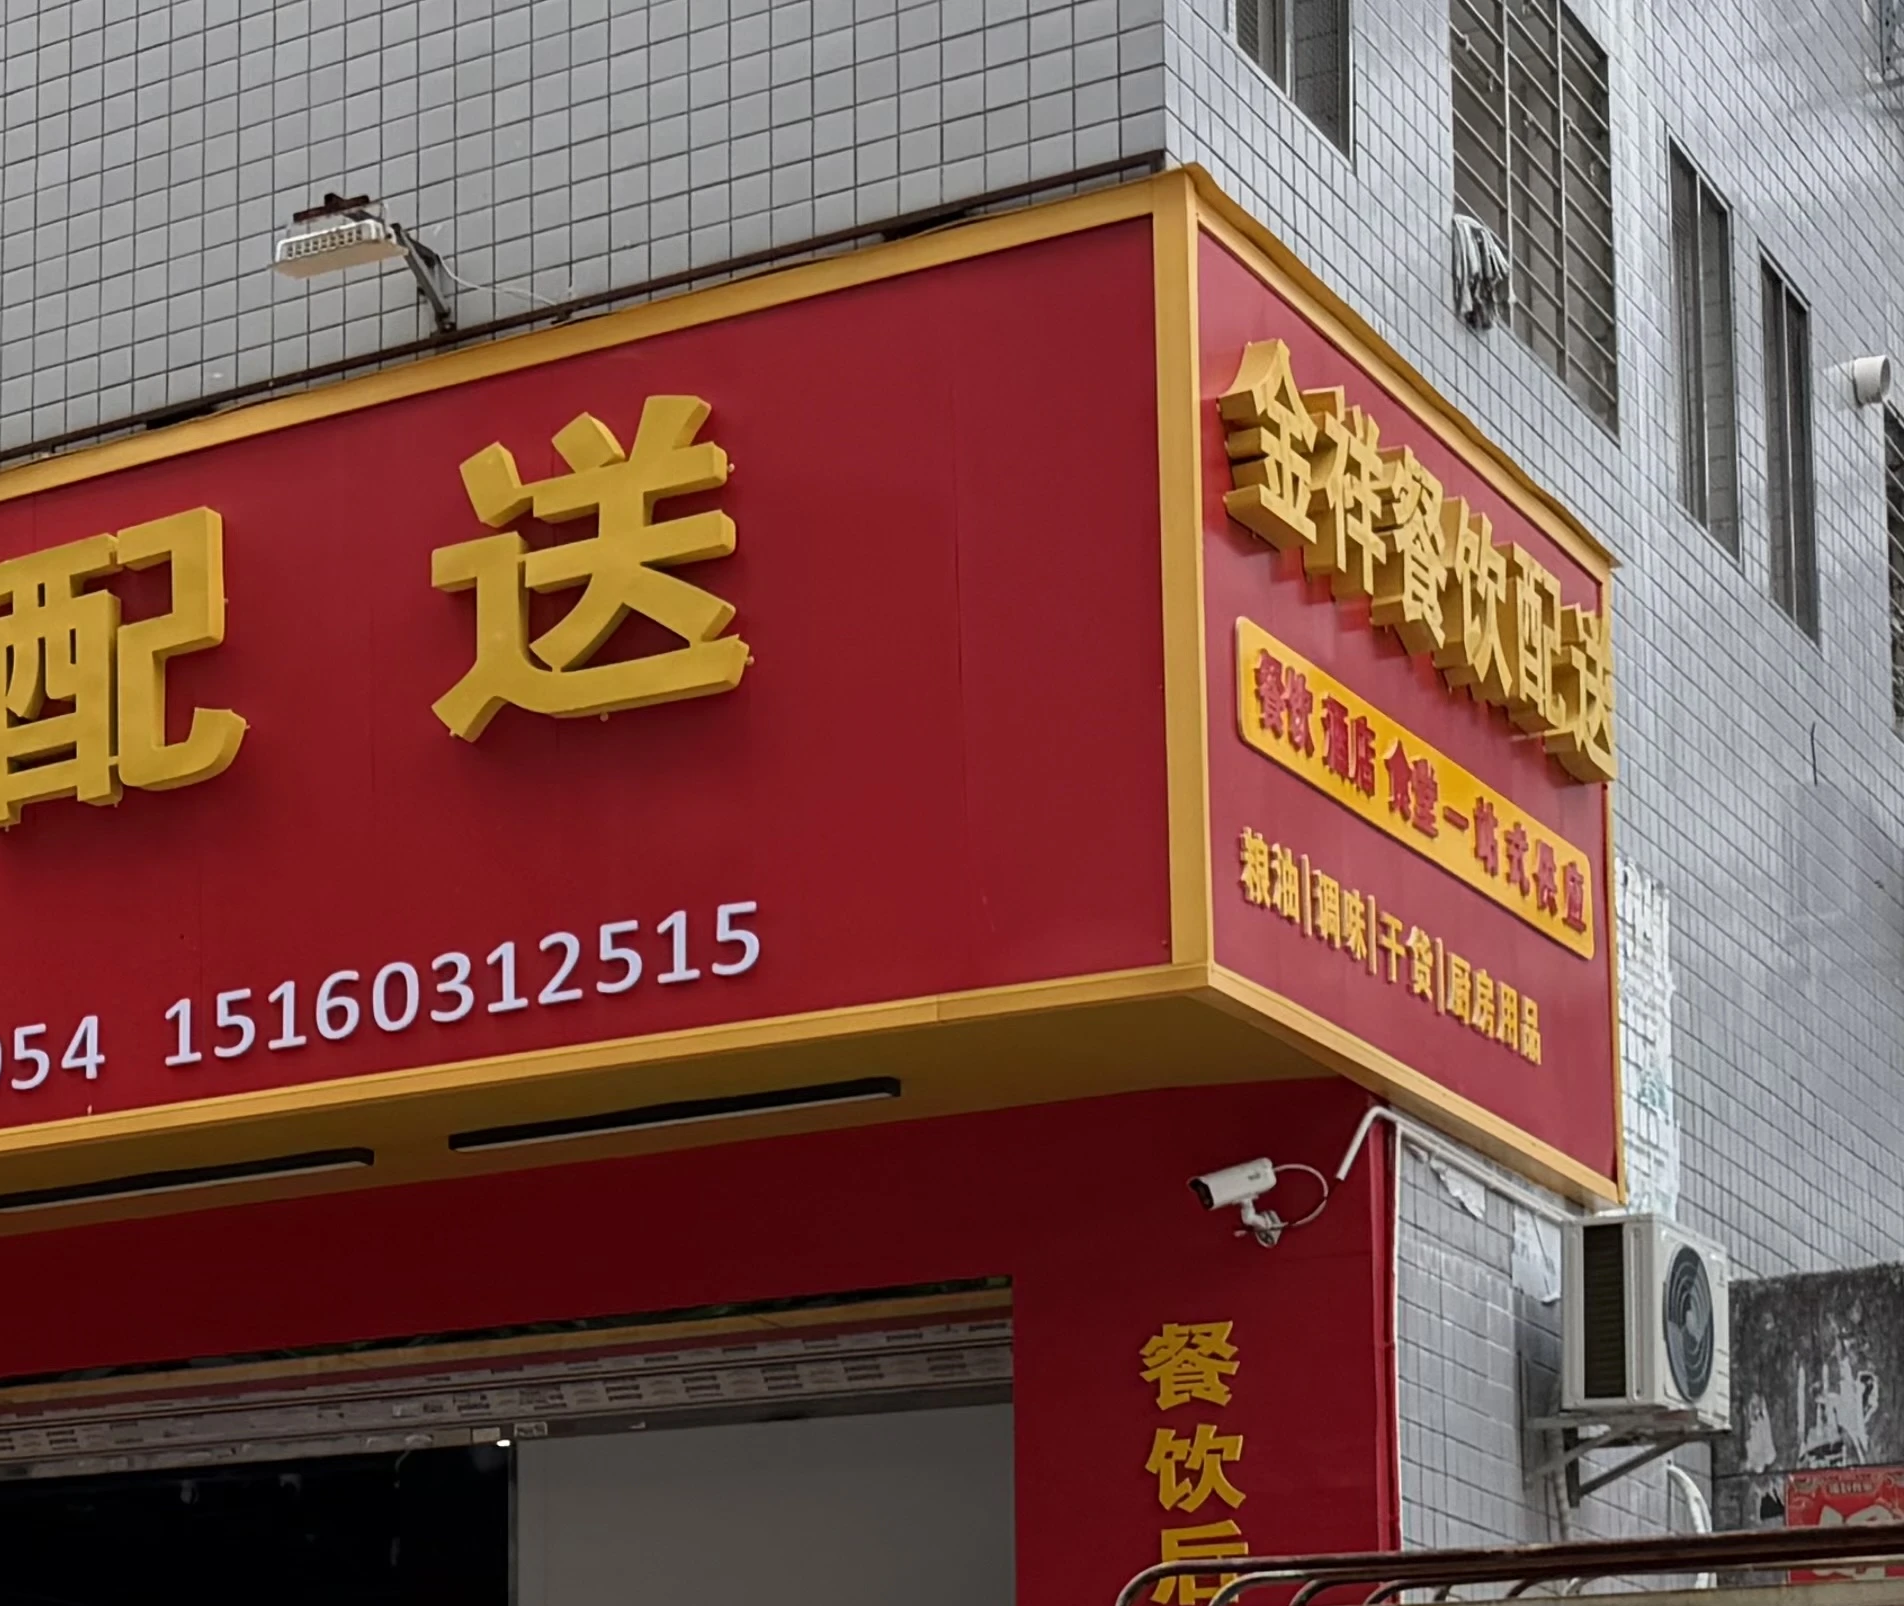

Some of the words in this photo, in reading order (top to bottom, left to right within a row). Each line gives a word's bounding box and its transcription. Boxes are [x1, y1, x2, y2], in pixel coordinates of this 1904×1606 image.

[1217, 339, 1617, 783] 金祥餐饮配送
[162, 898, 763, 1067] 15160312515
